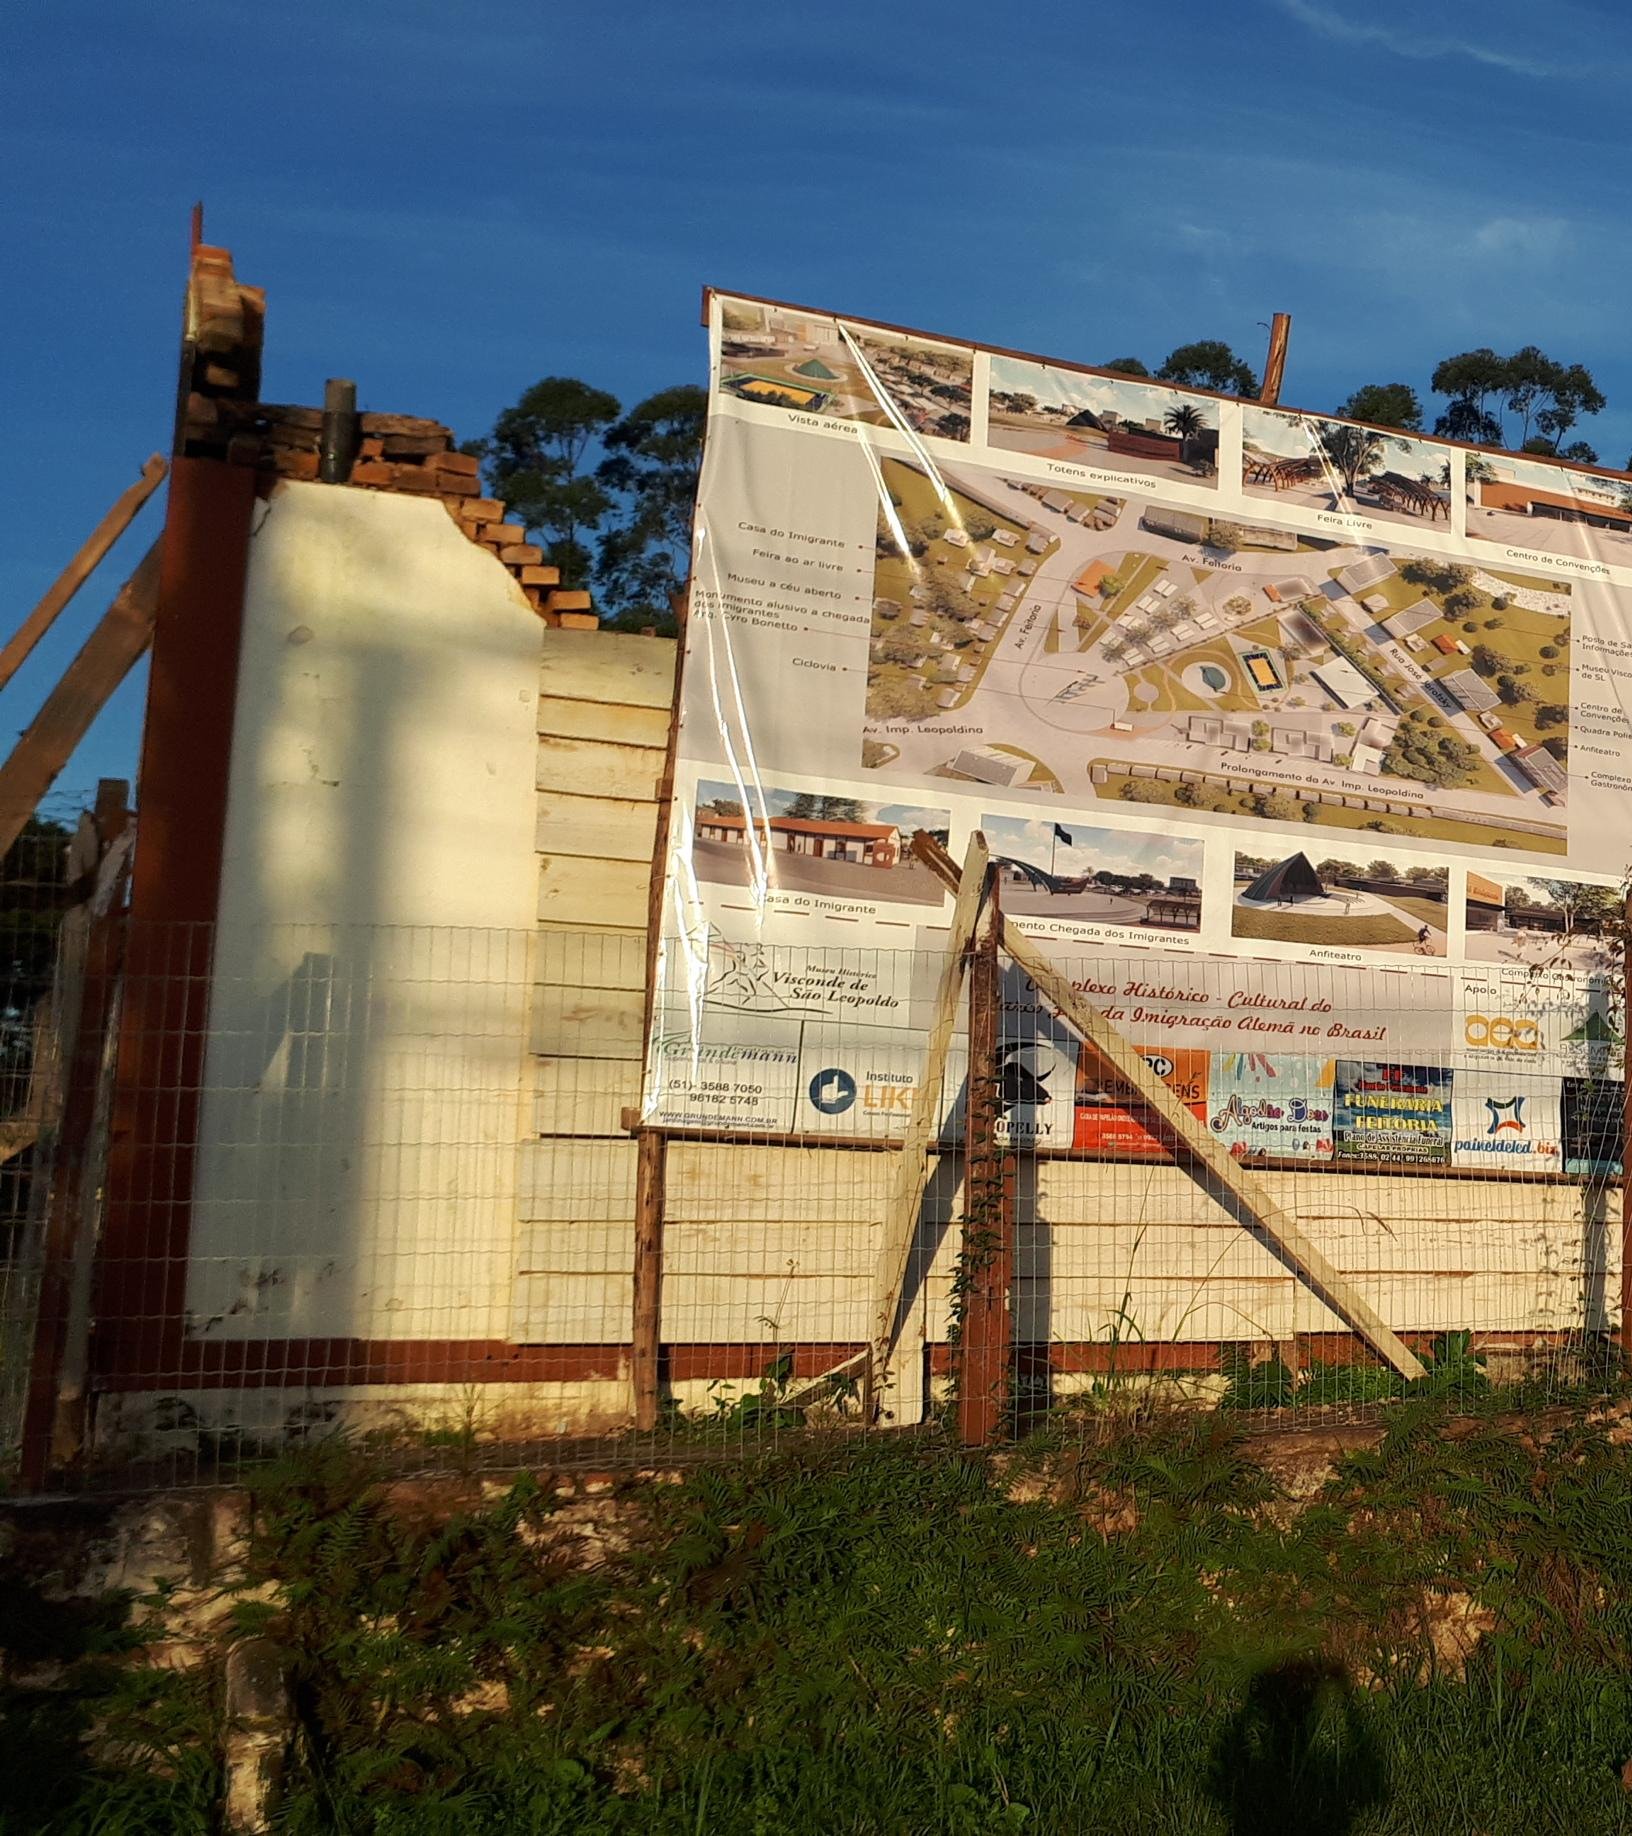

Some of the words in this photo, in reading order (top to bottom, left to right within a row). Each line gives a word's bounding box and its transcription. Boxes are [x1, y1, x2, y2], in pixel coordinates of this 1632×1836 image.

[788, 414, 819, 427] Vista
[823, 421, 858, 434] aérea
[1047, 463, 1086, 477] Totens
[1090, 472, 1156, 488] explicativos
[1317, 514, 1343, 526] Feira
[1346, 519, 1373, 530] Livre
[738, 522, 766, 534] Casa
[770, 528, 785, 538] do
[788, 532, 846, 549] Imigrante
[752, 548, 781, 562] Feira
[785, 555, 799, 565] ao
[803, 558, 815, 567] ar
[819, 561, 844, 573] livre
[1181, 554, 1199, 564] Av.
[1203, 557, 1242, 572] Feitoria
[1506, 549, 1539, 562] Centro
[1541, 556, 1553, 565] de
[1555, 558, 1611, 575] Convenções
[727, 573, 765, 587] Museu
[769, 580, 776, 589] a
[780, 582, 800, 593] céu
[804, 587, 842, 600] aberto
[695, 589, 763, 608] Monumento
[766, 601, 808, 615] alusivo
[811, 609, 818, 617] a
[822, 610, 871, 625] chegada
[751, 618, 799, 632] Bonetto
[1020, 603, 1042, 635] Feitoria
[1013, 636, 1028, 650] Av.
[1582, 635, 1605, 645] Posto
[792, 657, 837, 672] Ciclovia
[1390, 648, 1405, 664] Rua
[1405, 664, 1422, 680] José
[1581, 663, 1610, 674] Museu
[1581, 672, 1593, 680] de
[1594, 674, 1606, 682] SL
[1580, 702, 1609, 713] Centro
[1611, 707, 1623, 715] de
[1580, 710, 1630, 725] Convenções
[862, 726, 881, 735] Av.
[886, 726, 913, 736] Imp.
[1580, 726, 1611, 737] Quadra
[1580, 745, 1621, 757] Anfiteatro
[1221, 762, 1303, 781] Prolongamento
[1305, 774, 1319, 784] da
[1322, 778, 1339, 787] Av.
[1341, 780, 1364, 792] Imp.
[1367, 784, 1424, 799] Leopoldina
[1591, 771, 1632, 784] Complexo
[766, 894, 790, 905] asa
[794, 897, 810, 907] do
[814, 899, 876, 915] Imigrante
[1049, 923, 1101, 938] Chegada
[1104, 928, 1125, 939] dos
[1128, 931, 1190, 946] Imigrantes
[1309, 949, 1362, 961] Anfiteatro
[806, 964, 836, 975] Museu
[773, 971, 846, 988] Visconde
[849, 979, 869, 991] de
[790, 987, 821, 1000] São
[827, 990, 900, 1008] Leopoldo
[1123, 981, 1210, 1003] Histórico
[1227, 991, 1308, 1012] Cultural
[1308, 998, 1332, 1013] do
[1464, 984, 1497, 995] Apoio
[1100, 1005, 1125, 1020] da
[1130, 1007, 1232, 1031] Imigração
[1237, 1016, 1295, 1034] Alemã
[1298, 1024, 1321, 1036] no
[1327, 1023, 1387, 1041] Brasil
[663, 1043, 798, 1065] Grndemann
[866, 1071, 914, 1084] Instituto
[701, 1081, 730, 1092] 3588
[733, 1083, 762, 1094] 7050
[864, 1084, 916, 1110] LIK
[1251, 1122, 1278, 1132] Artigos
[1280, 1124, 1297, 1133] para
[1298, 1124, 1321, 1133] festas
[1355, 1115, 1439, 1132] FEITORIA
[1366, 1132, 1377, 1143] de
